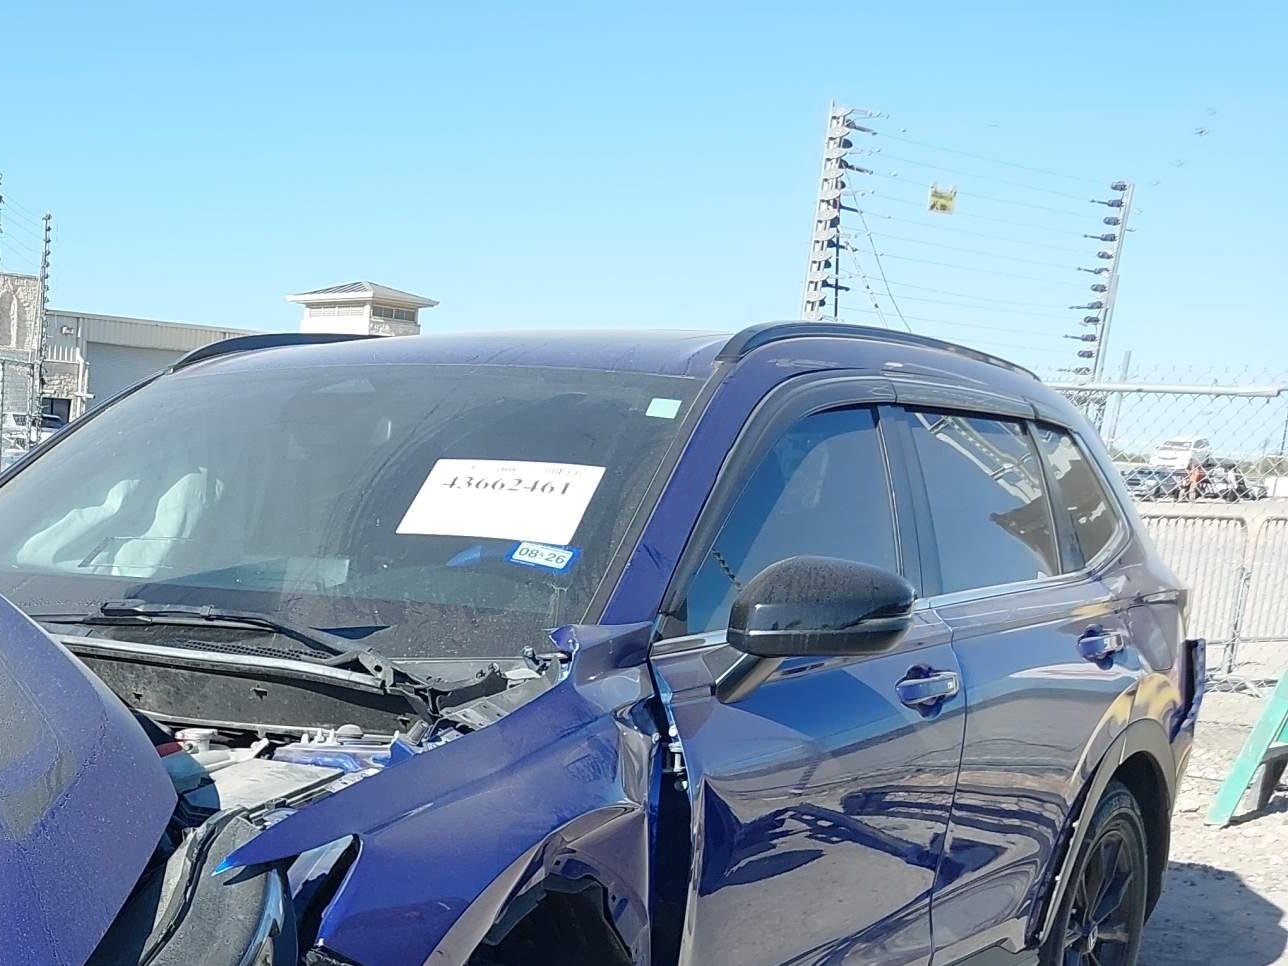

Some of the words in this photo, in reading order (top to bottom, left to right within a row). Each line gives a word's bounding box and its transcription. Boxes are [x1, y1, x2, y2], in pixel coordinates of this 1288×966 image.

[442, 476, 571, 495] 43662461
[518, 547, 540, 558] 08
[545, 552, 567, 564] 26
